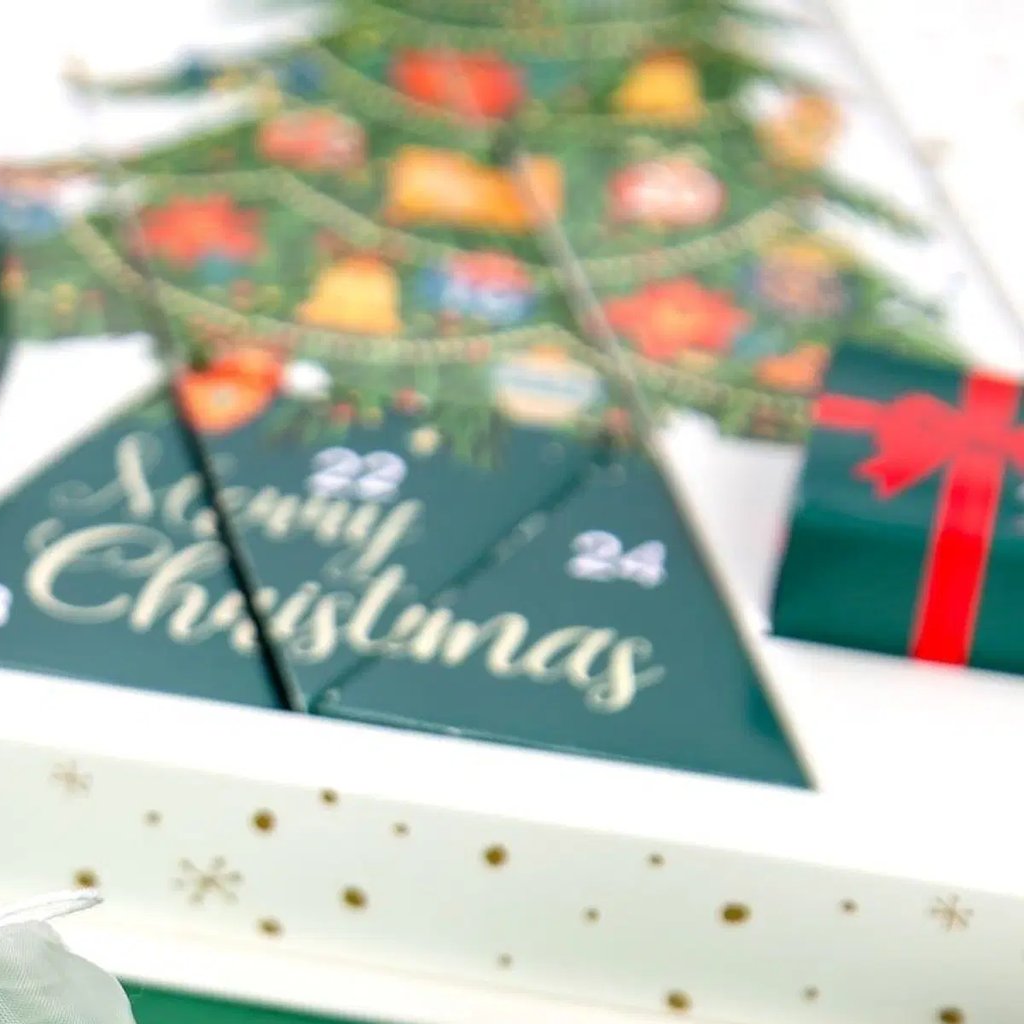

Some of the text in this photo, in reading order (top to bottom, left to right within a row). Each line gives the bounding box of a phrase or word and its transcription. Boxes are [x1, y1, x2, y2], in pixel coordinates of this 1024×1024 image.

[306, 446, 408, 500] 22
[565, 528, 668, 590] 24
[24, 514, 666, 714] Christmas
